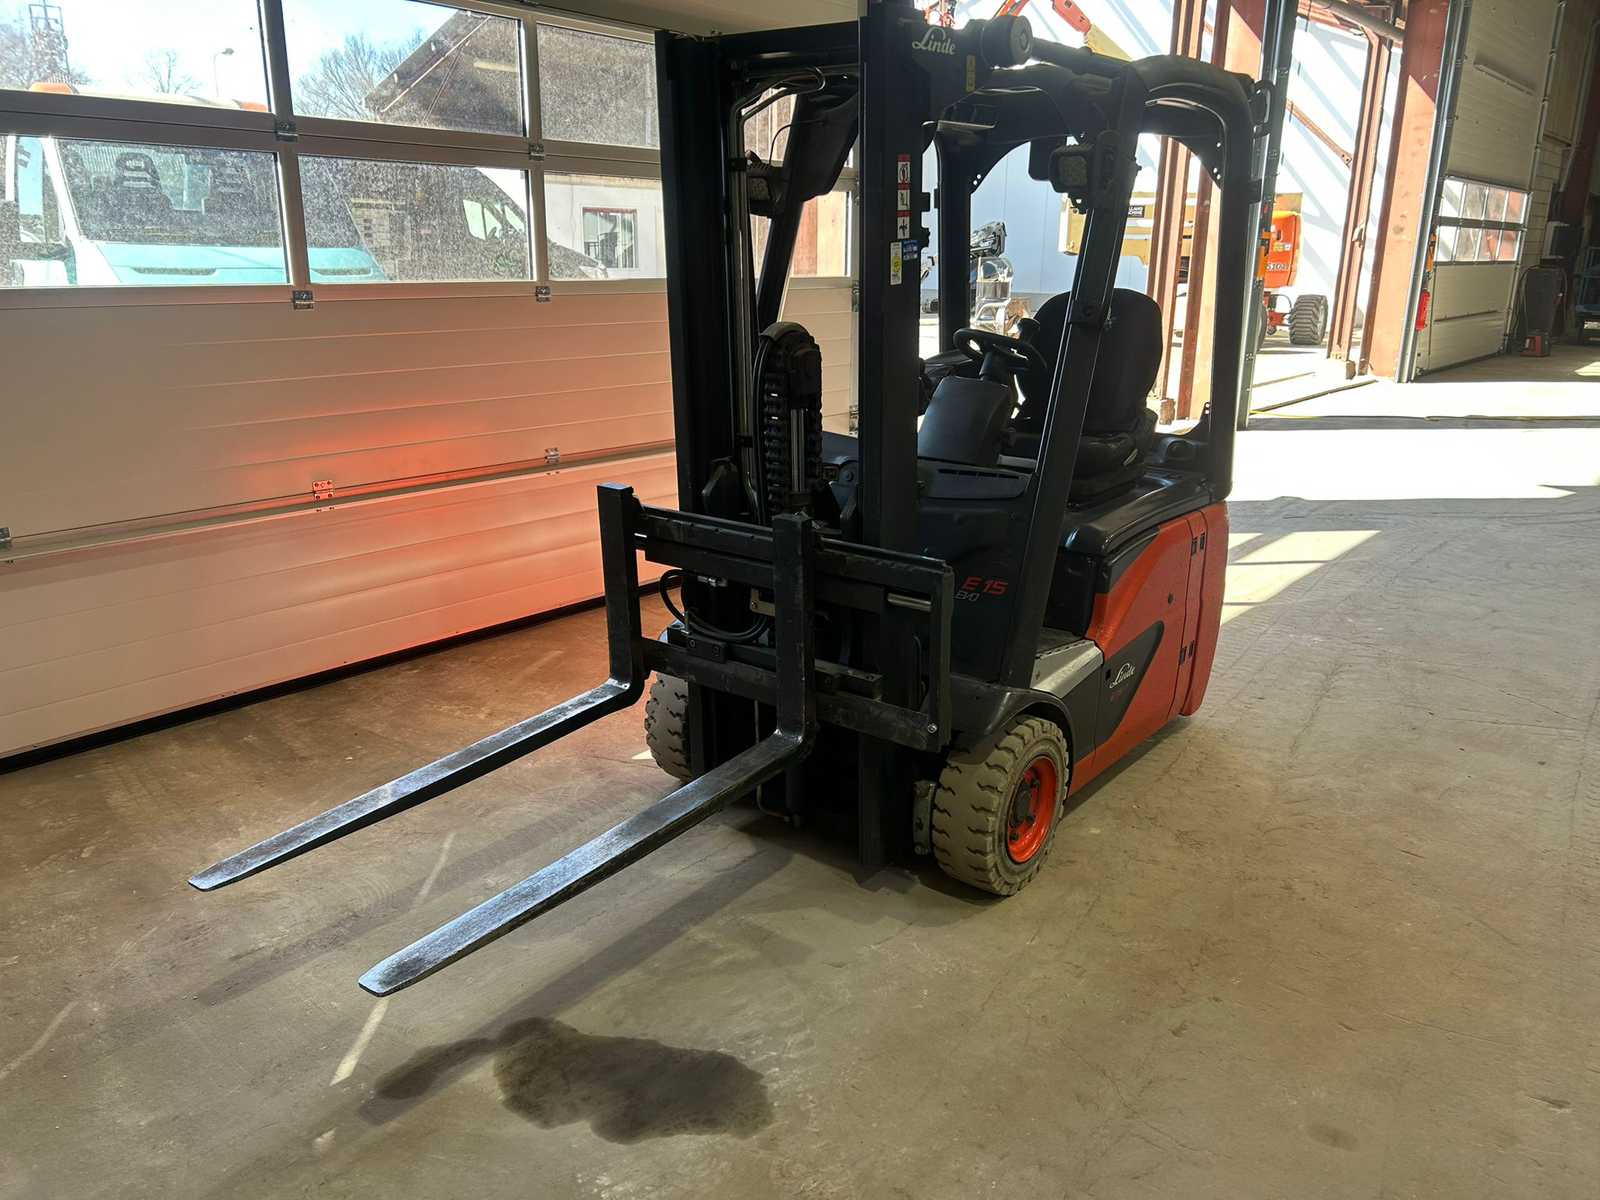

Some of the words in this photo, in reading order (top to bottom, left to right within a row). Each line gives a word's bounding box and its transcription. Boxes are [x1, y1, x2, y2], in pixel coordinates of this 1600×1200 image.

[911, 26, 956, 55] Linde
[961, 576, 981, 591] E
[983, 579, 1008, 596] 15
[1109, 662, 1136, 689] Linde
